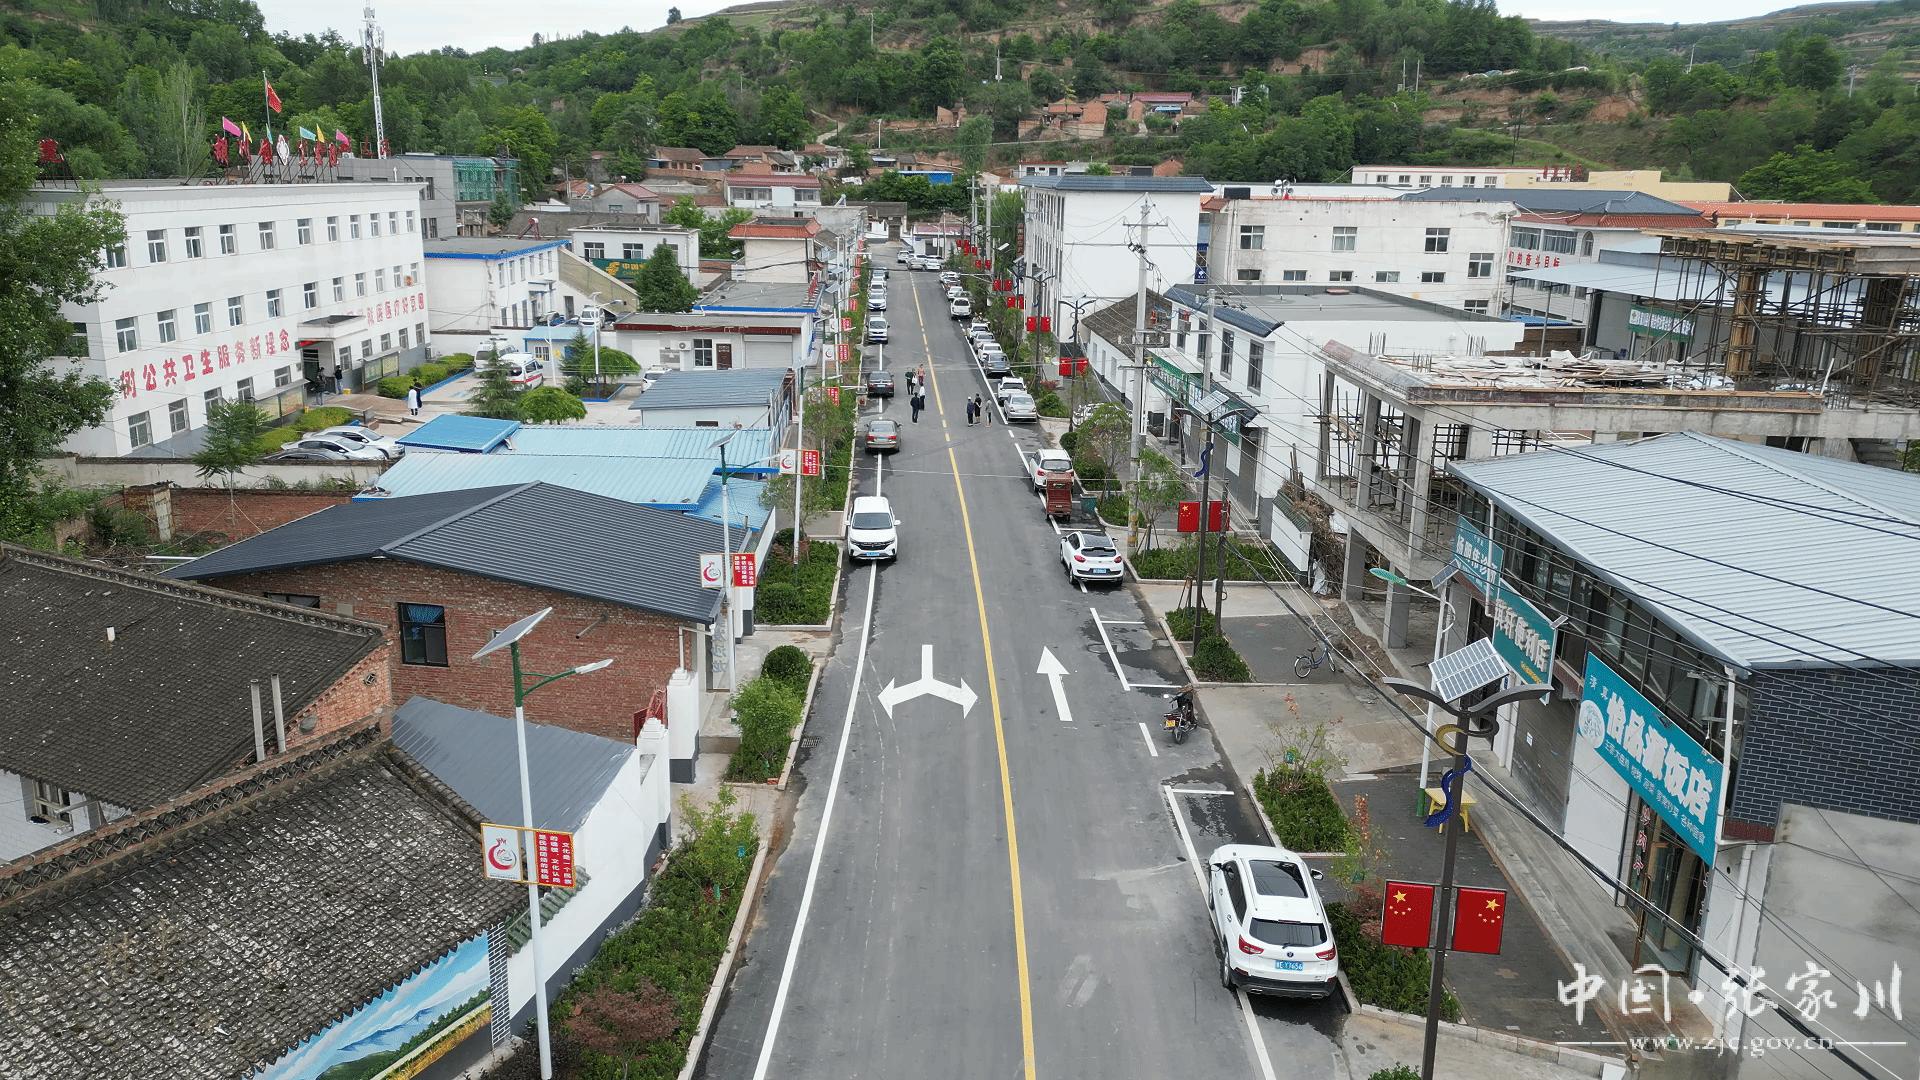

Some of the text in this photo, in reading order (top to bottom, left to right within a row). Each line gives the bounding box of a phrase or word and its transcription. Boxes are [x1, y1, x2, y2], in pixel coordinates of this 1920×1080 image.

[120, 328, 290, 400] 树公共卫生服务新理念
